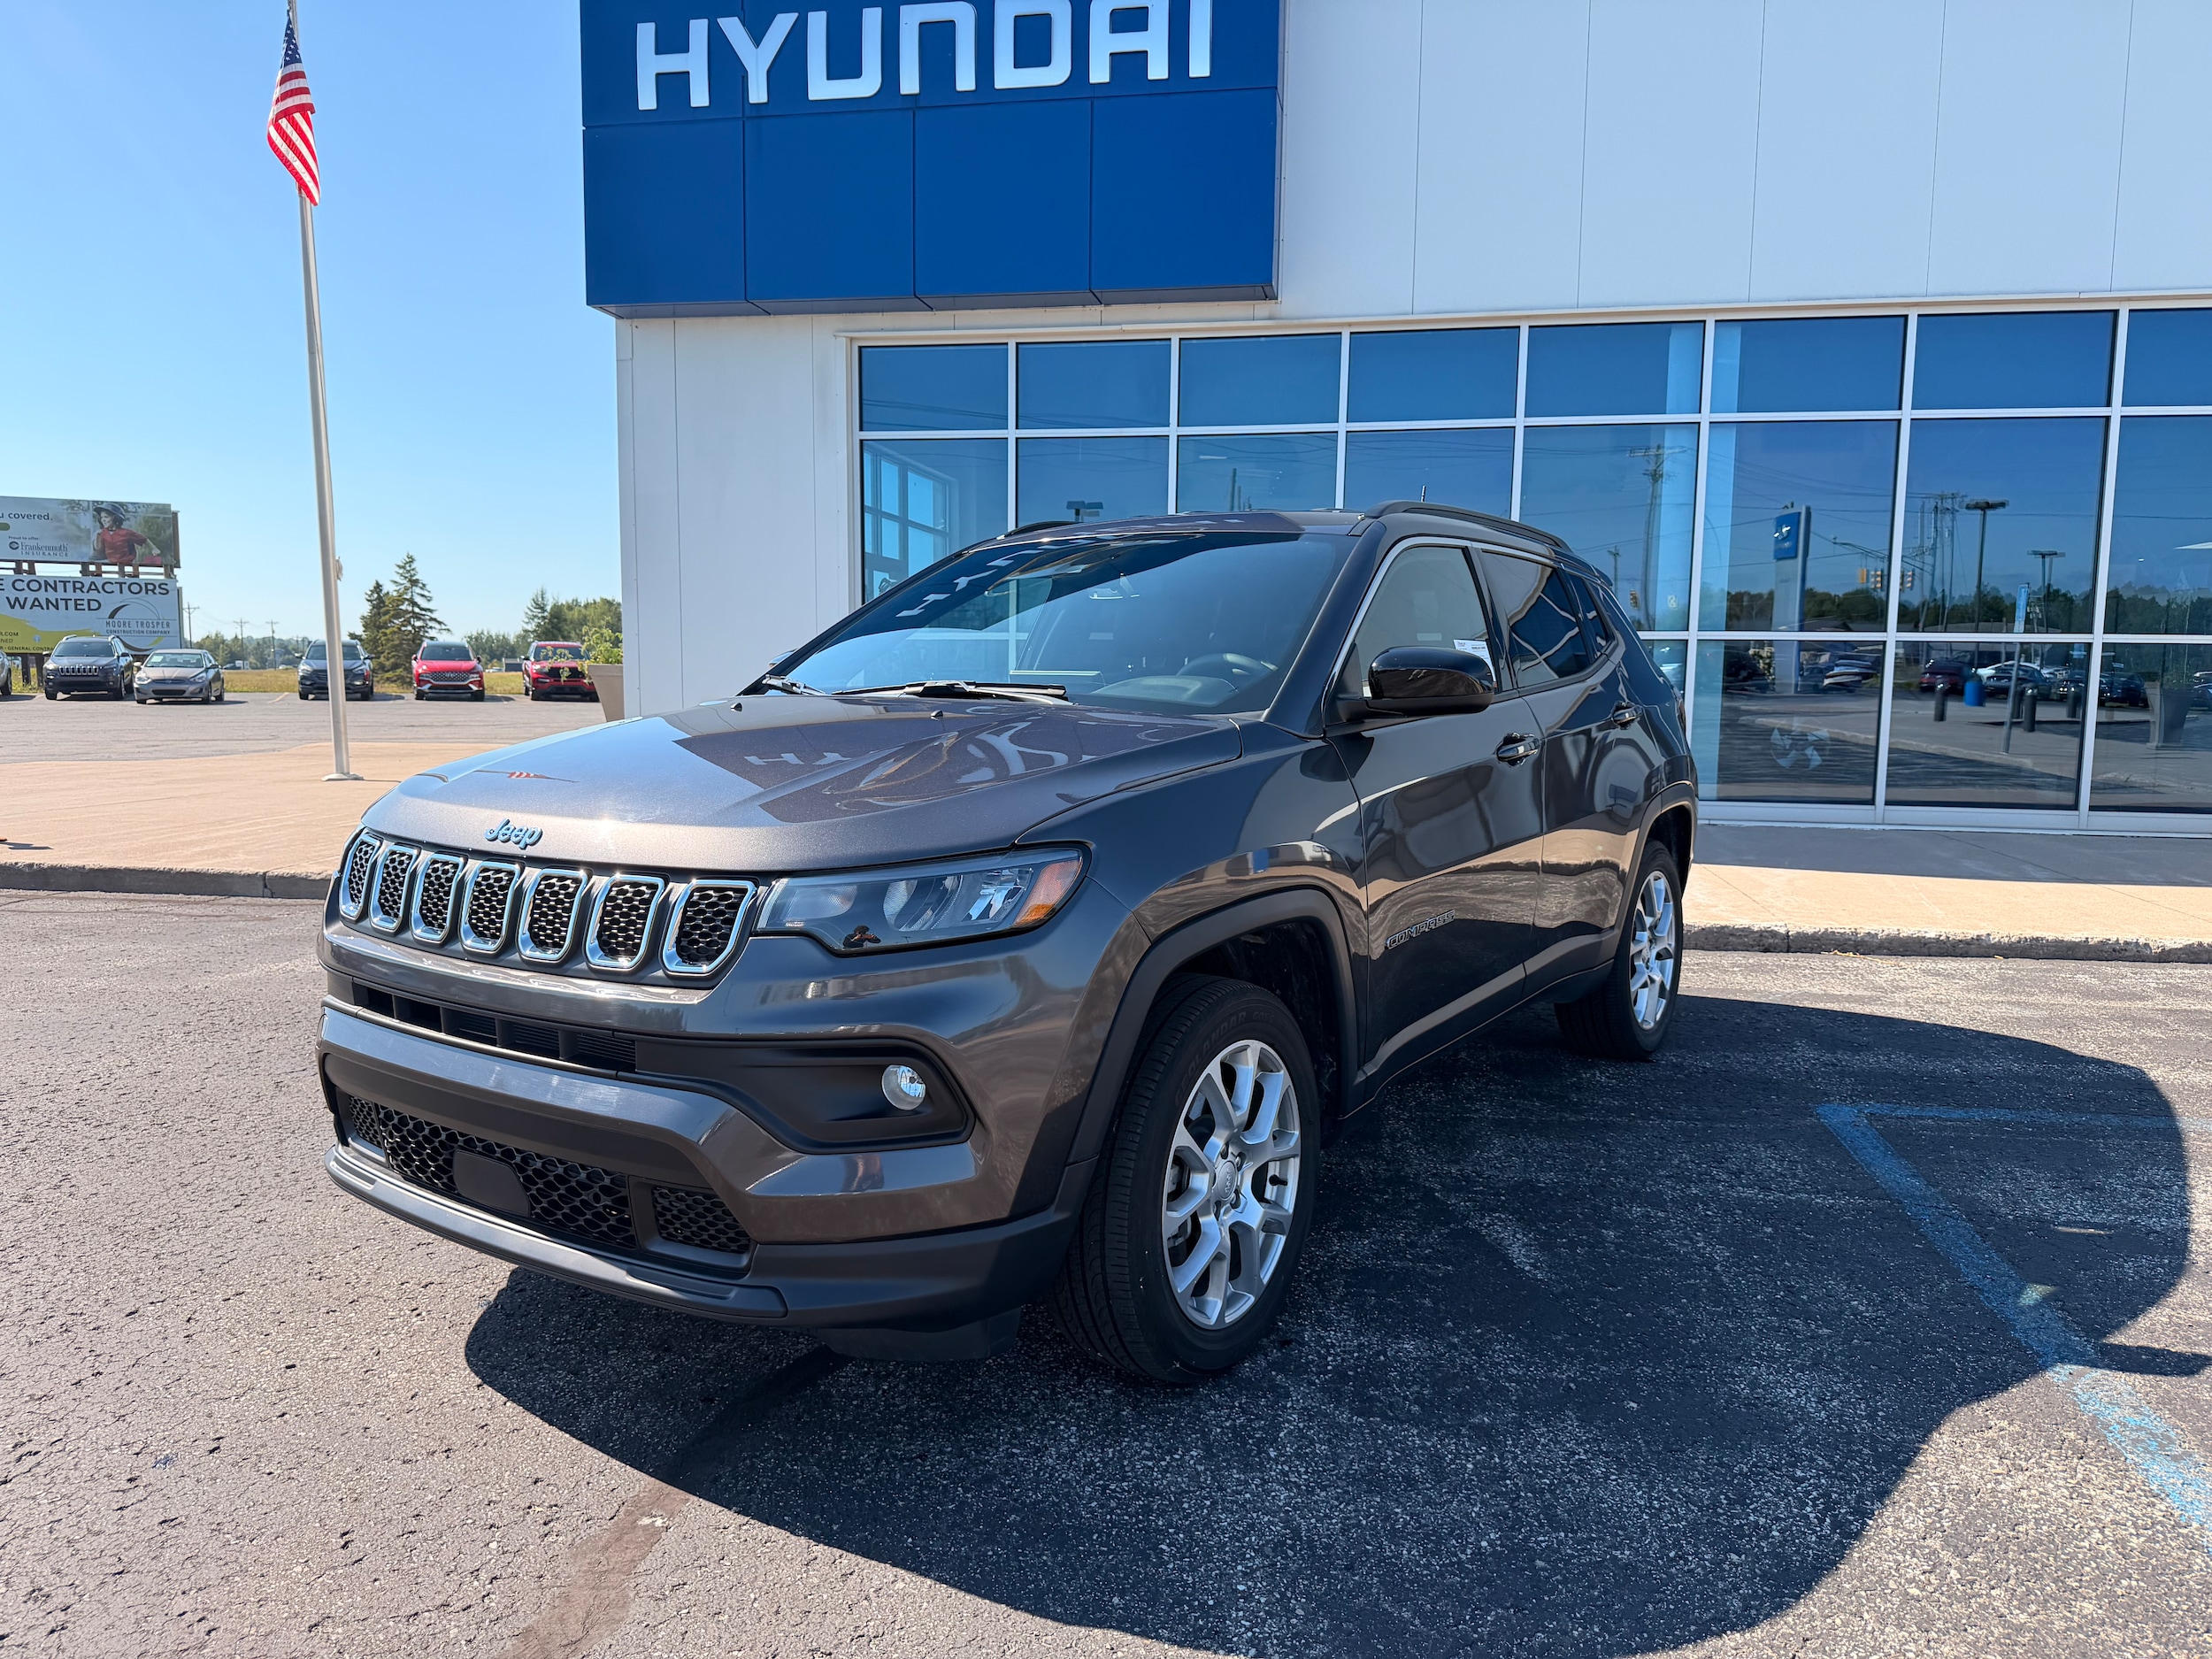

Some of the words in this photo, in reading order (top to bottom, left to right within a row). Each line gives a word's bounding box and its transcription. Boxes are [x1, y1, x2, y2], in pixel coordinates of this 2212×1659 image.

[636, 0, 1212, 111] HYUNDAI
[8, 512, 53, 521] covered.
[20, 541, 69, 552] Frankenmuth
[12, 579, 170, 595] CONTRACTORS
[5, 596, 102, 611] WANTED
[484, 818, 543, 850] Jeep
[1385, 910, 1455, 950] COMPASS
[1175, 1011, 1247, 1108] GEOLANDAR
